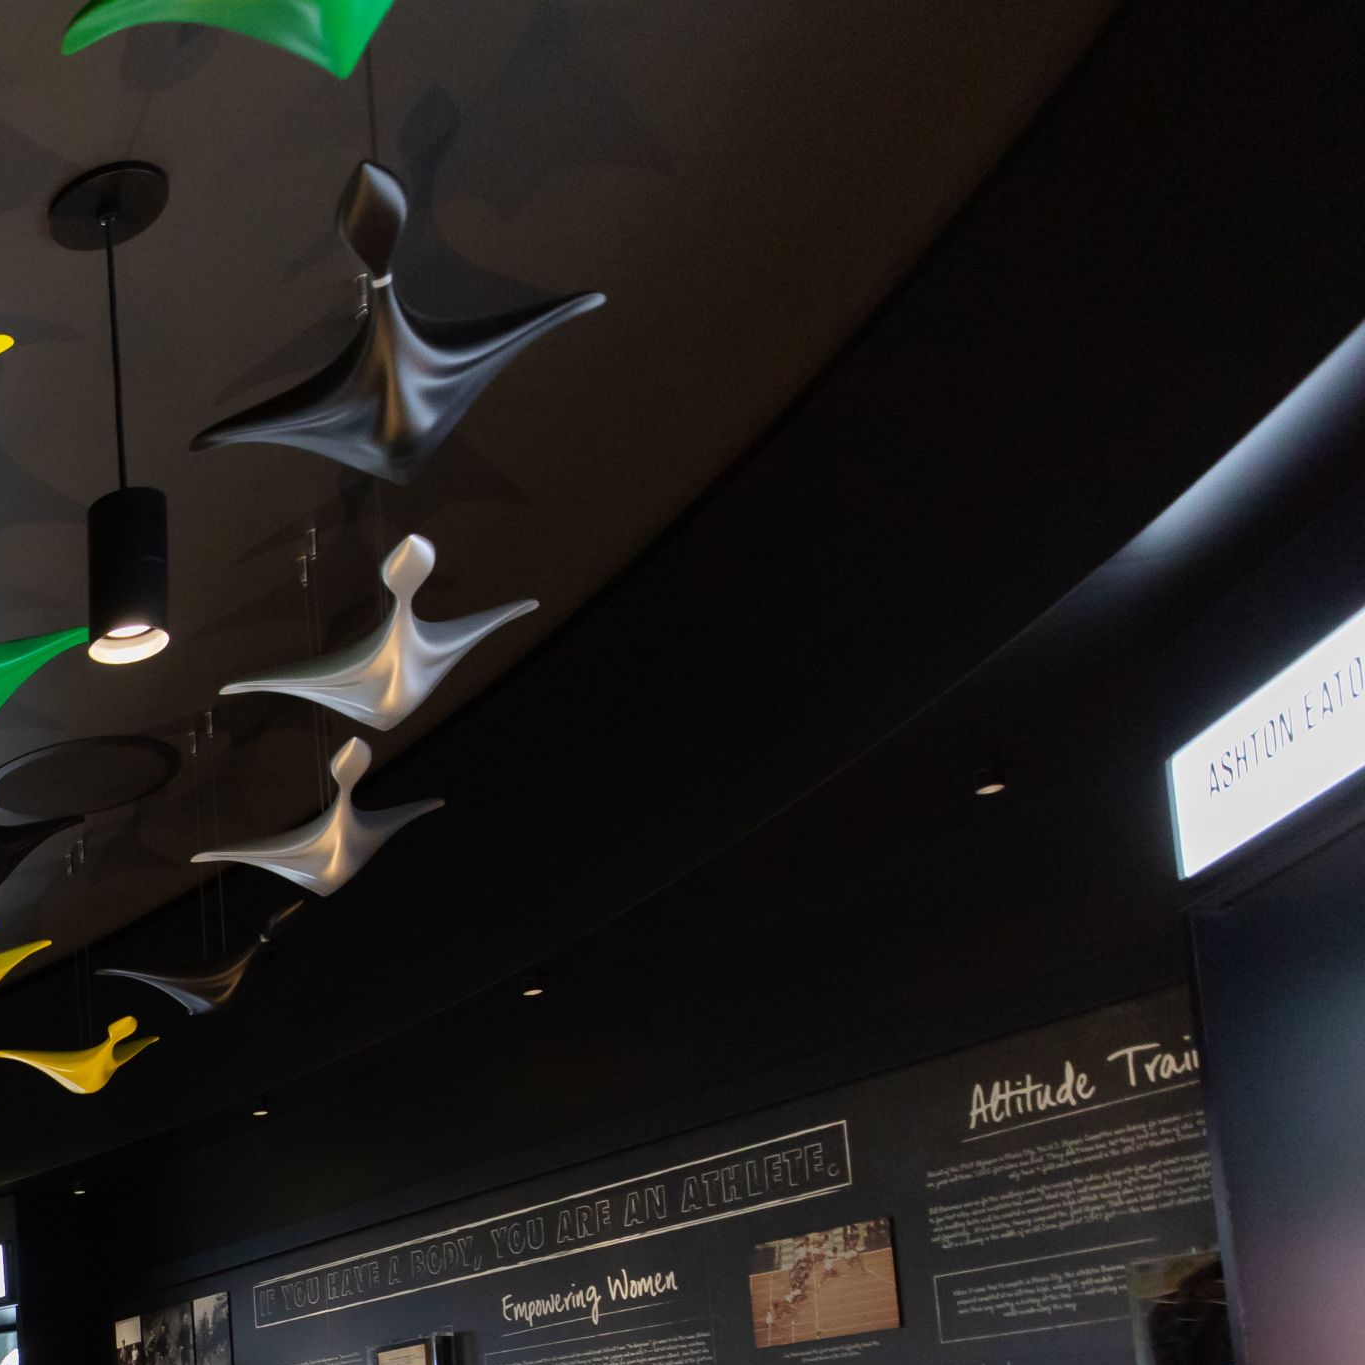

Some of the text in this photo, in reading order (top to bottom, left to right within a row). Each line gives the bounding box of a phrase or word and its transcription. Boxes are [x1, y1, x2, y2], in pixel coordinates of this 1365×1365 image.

[1209, 708, 1294, 799] ASHTON
[969, 1061, 1096, 1130] Altitude
[259, 1142, 841, 1317] IF YOU HAVE A BODY, YOU ARE AN ATHLETE.
[501, 1268, 679, 1326] Empowering Women
